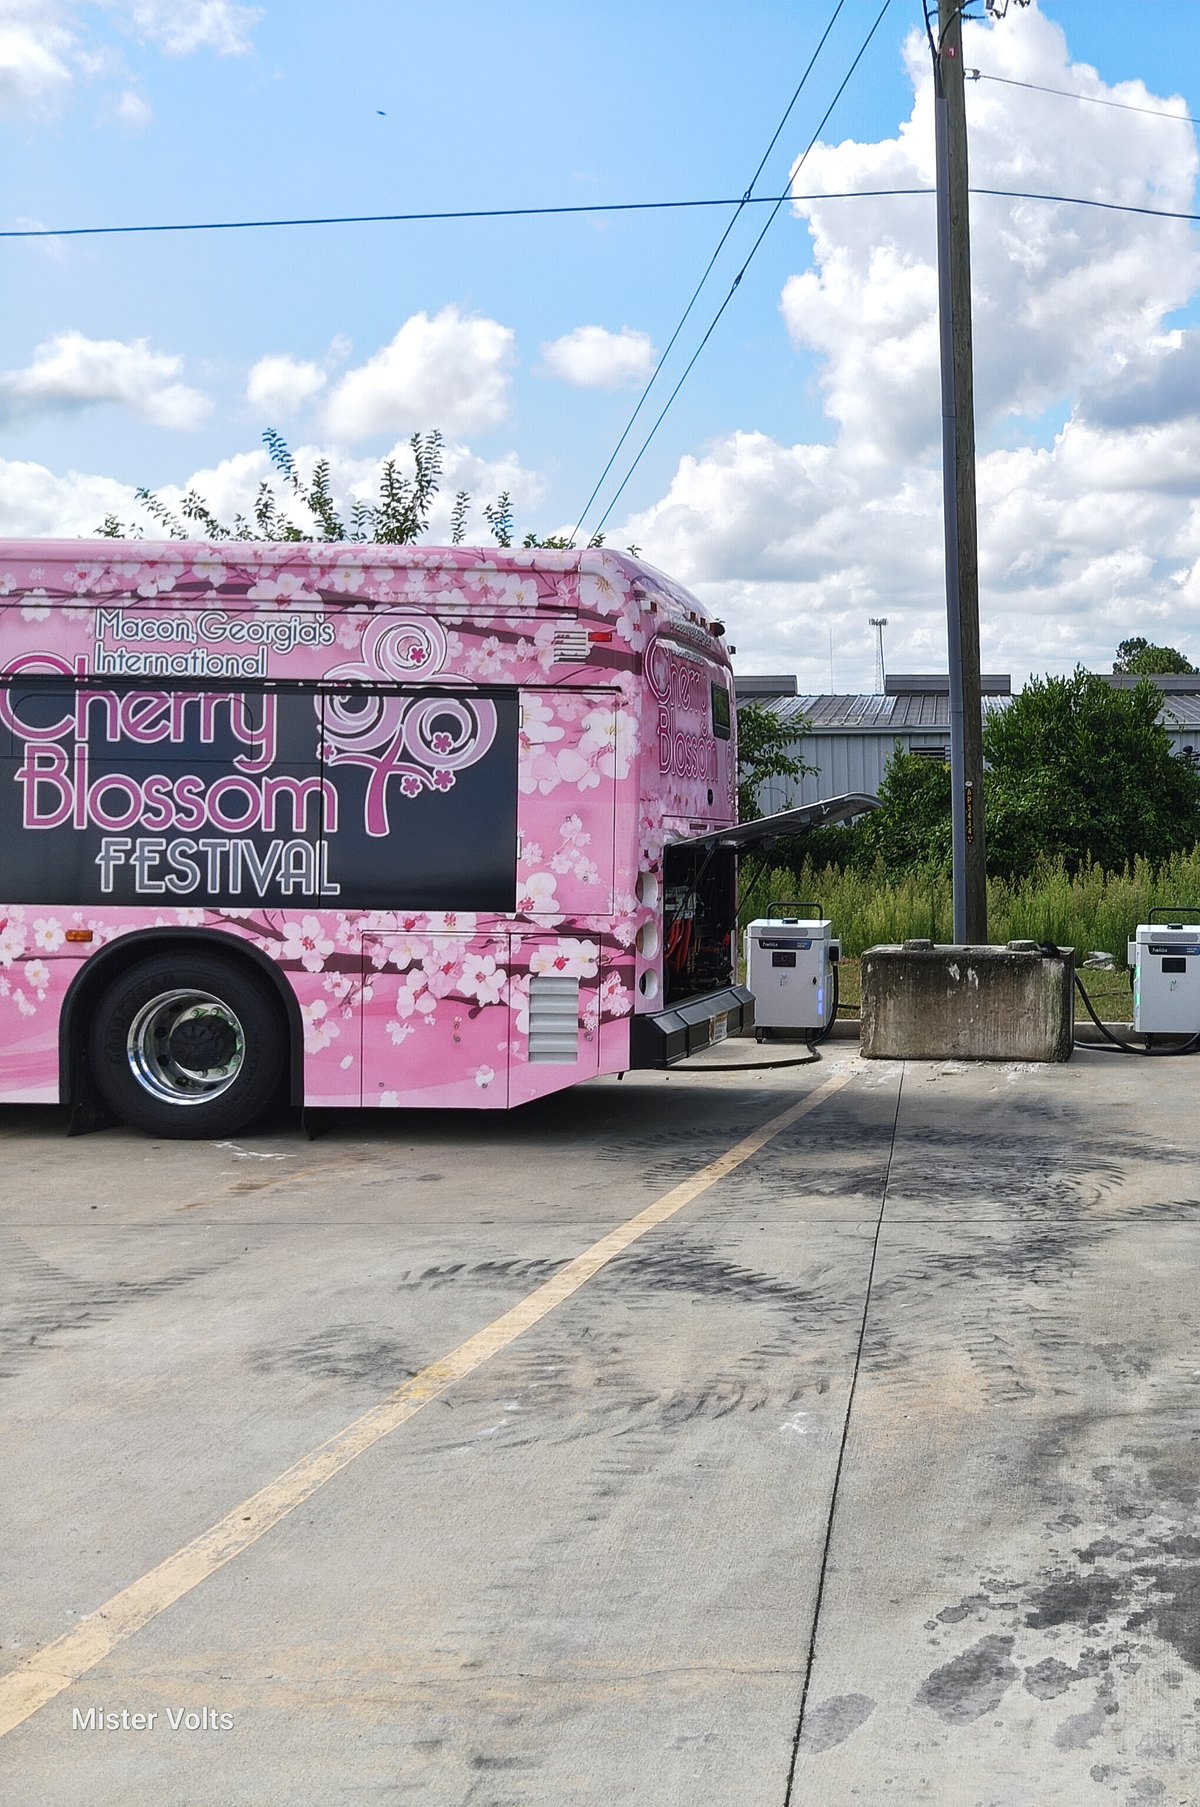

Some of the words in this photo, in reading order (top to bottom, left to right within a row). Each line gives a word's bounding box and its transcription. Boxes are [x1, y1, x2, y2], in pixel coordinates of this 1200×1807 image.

[94, 643, 268, 678] International
[95, 608, 197, 644] Macon,
[197, 612, 336, 654] Georgia's
[0, 651, 278, 773] Cherry
[656, 704, 719, 783] Blossom
[14, 742, 338, 832] Blossom
[96, 838, 340, 897] FESTIVAL
